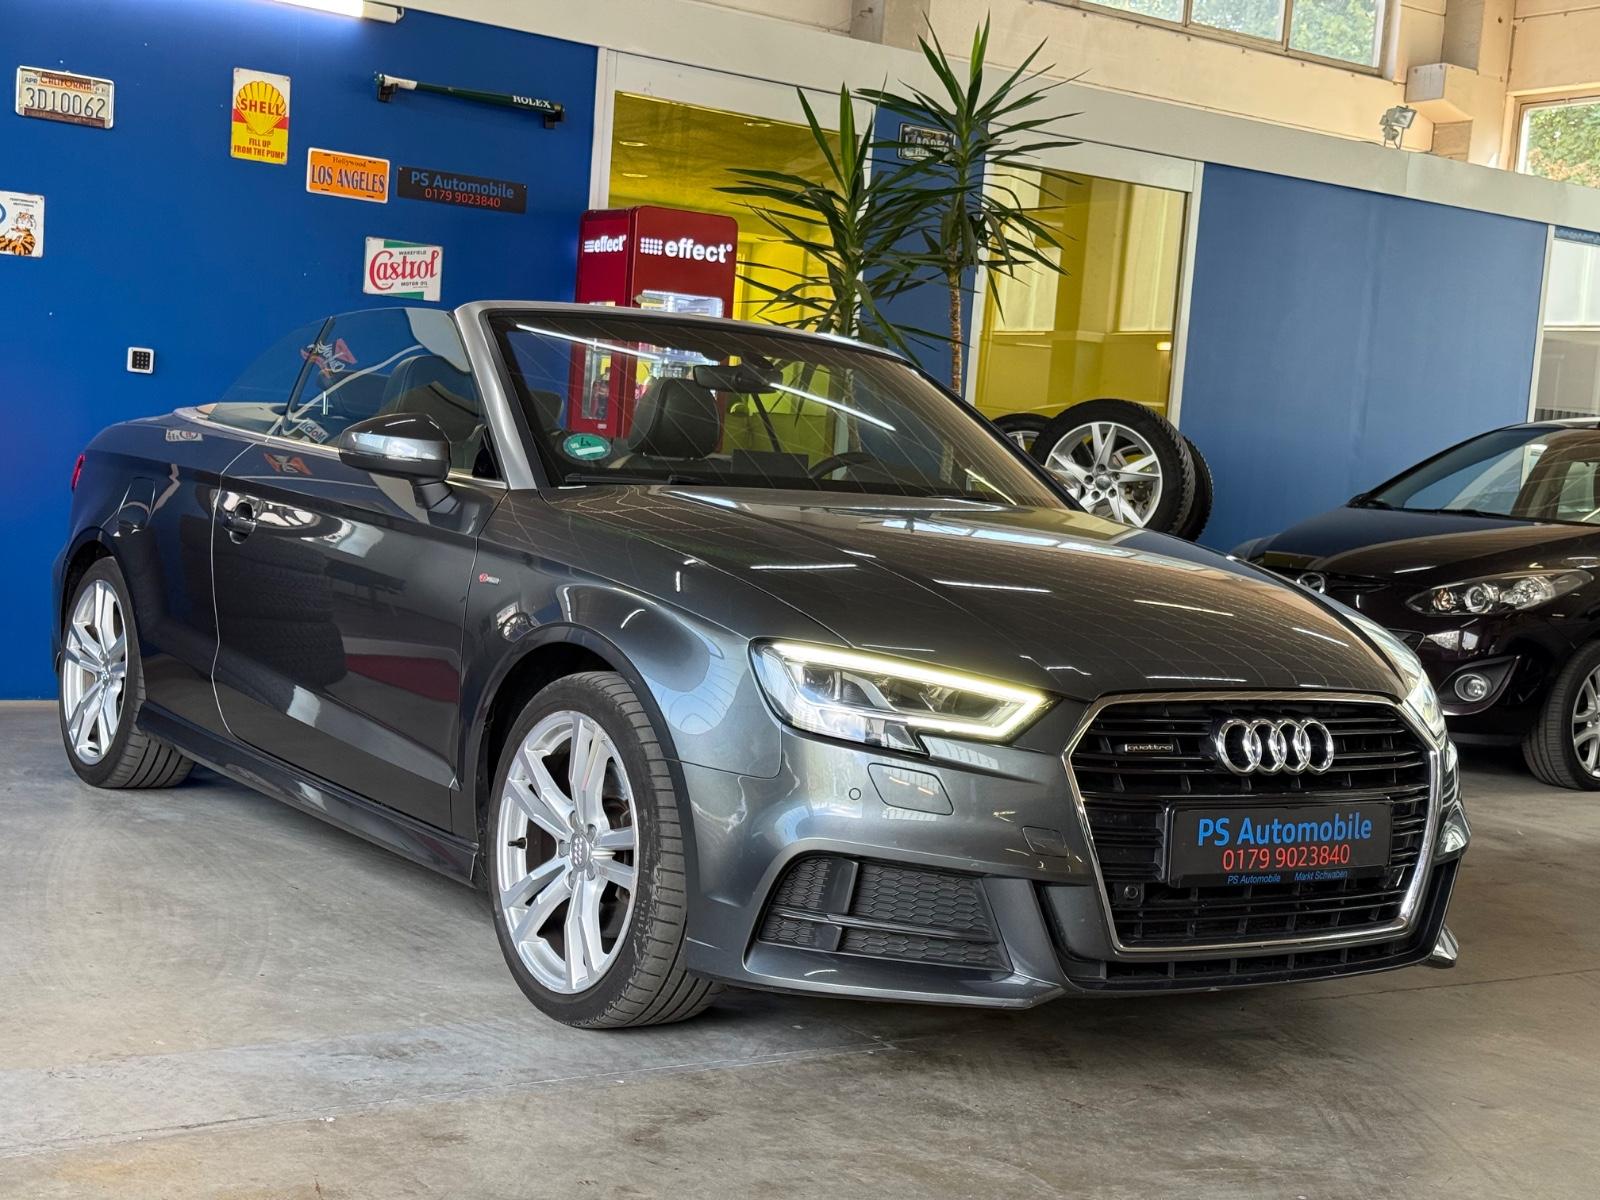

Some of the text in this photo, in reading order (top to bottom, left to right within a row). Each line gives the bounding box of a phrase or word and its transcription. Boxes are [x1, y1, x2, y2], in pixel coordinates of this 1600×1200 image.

[25, 87, 106, 118] 3D10062
[240, 98, 282, 116] SHELL
[512, 95, 551, 109] ROLEX
[248, 137, 271, 148] FILL UP
[233, 145, 285, 160] FROM THE PUMP
[332, 156, 367, 168] Hollywood
[311, 164, 386, 194] LOS ANGELES
[411, 171, 514, 199] PS Automobile
[425, 187, 501, 208] 0179 9023840
[369, 249, 440, 291] Castrol
[1127, 744, 1172, 752] quattro
[1198, 812, 1373, 847] PS Automobile
[1222, 844, 1350, 871] 0179 9023840
[1227, 870, 1348, 885] PS Automobile Markt Schwaben
